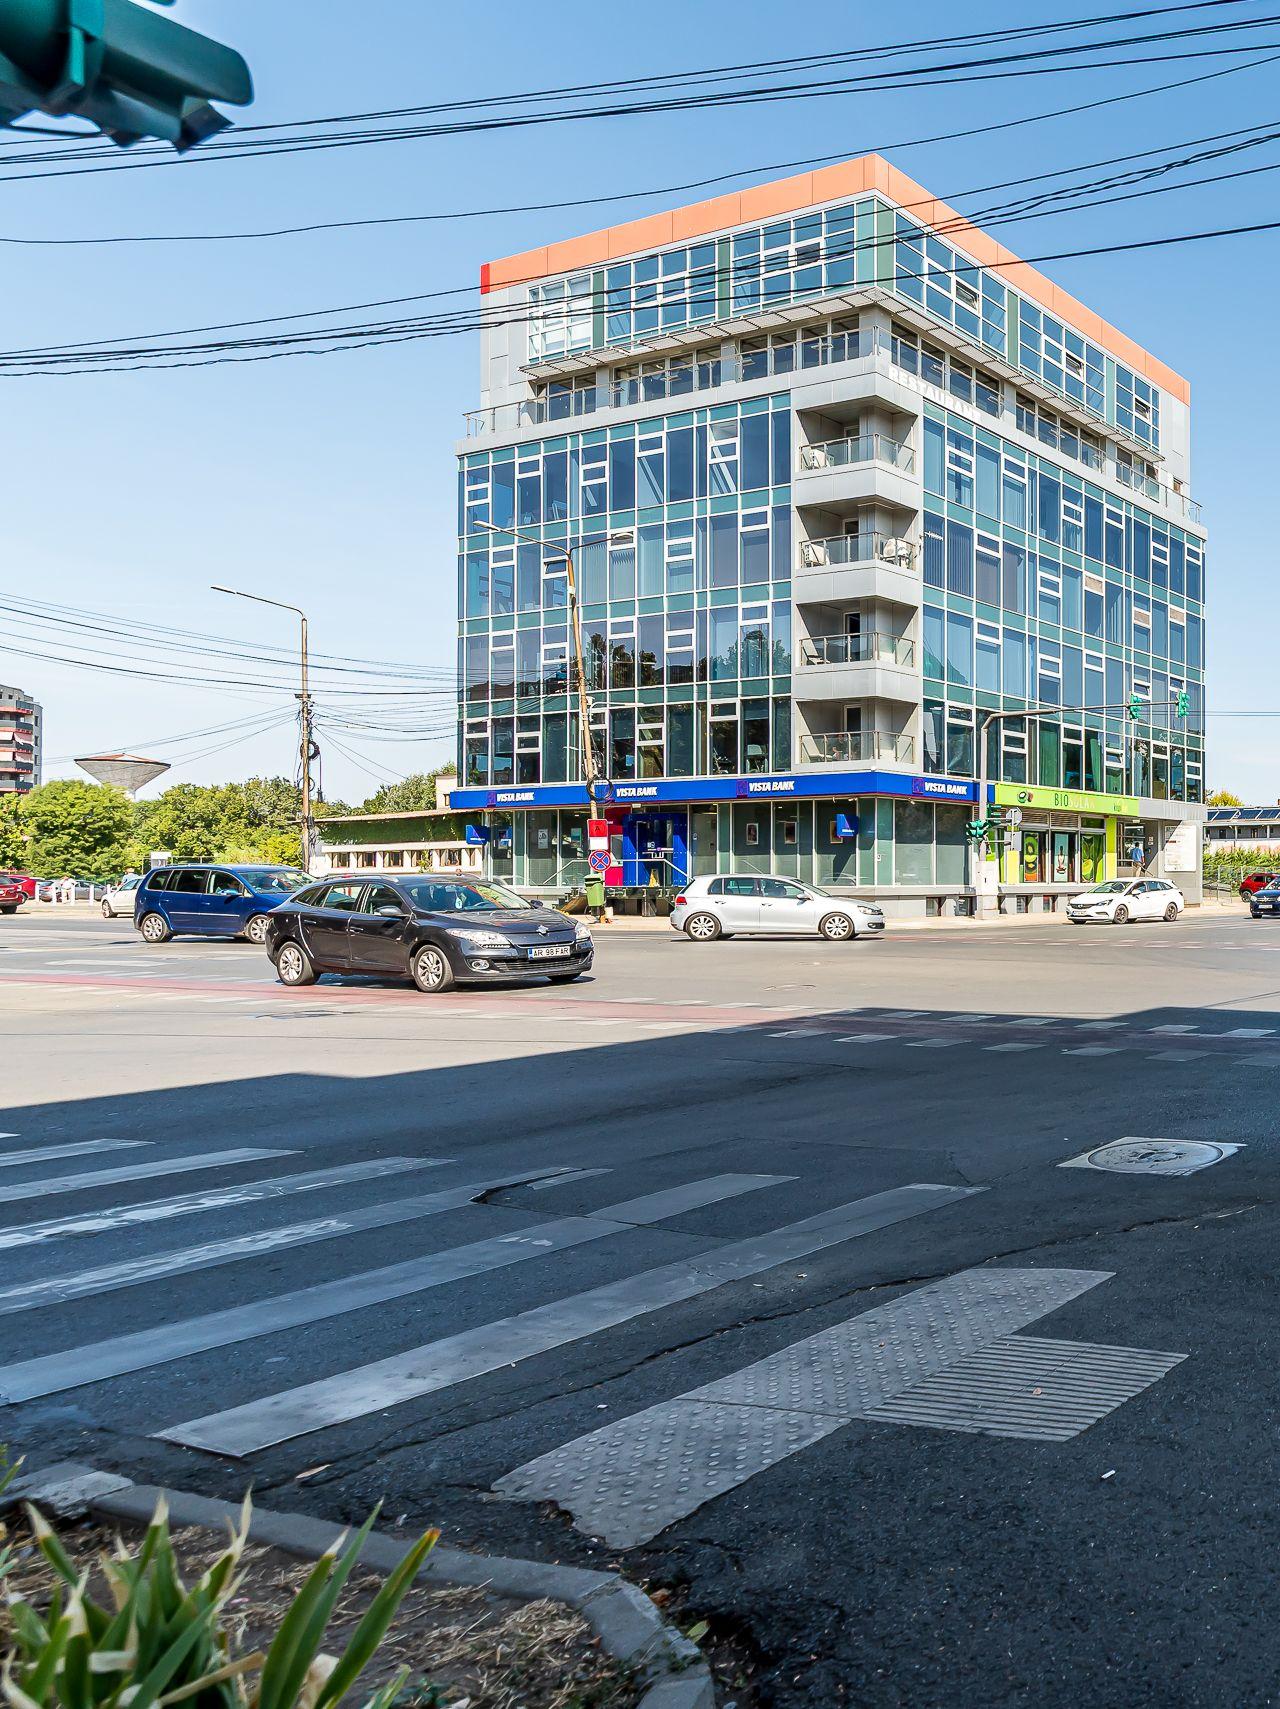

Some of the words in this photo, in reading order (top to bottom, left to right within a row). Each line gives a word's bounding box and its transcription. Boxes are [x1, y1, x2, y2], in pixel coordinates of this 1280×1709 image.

[889, 365, 981, 422] RESTAURANT
[617, 788, 636, 797] VISTA
[637, 787, 657, 796] BANK
[749, 782, 771, 792] VISTA
[772, 781, 795, 791] BANK
[925, 782, 945, 793] VISTA
[947, 784, 967, 795] BANK
[496, 793, 515, 802] VISTA
[516, 792, 535, 801] BANK
